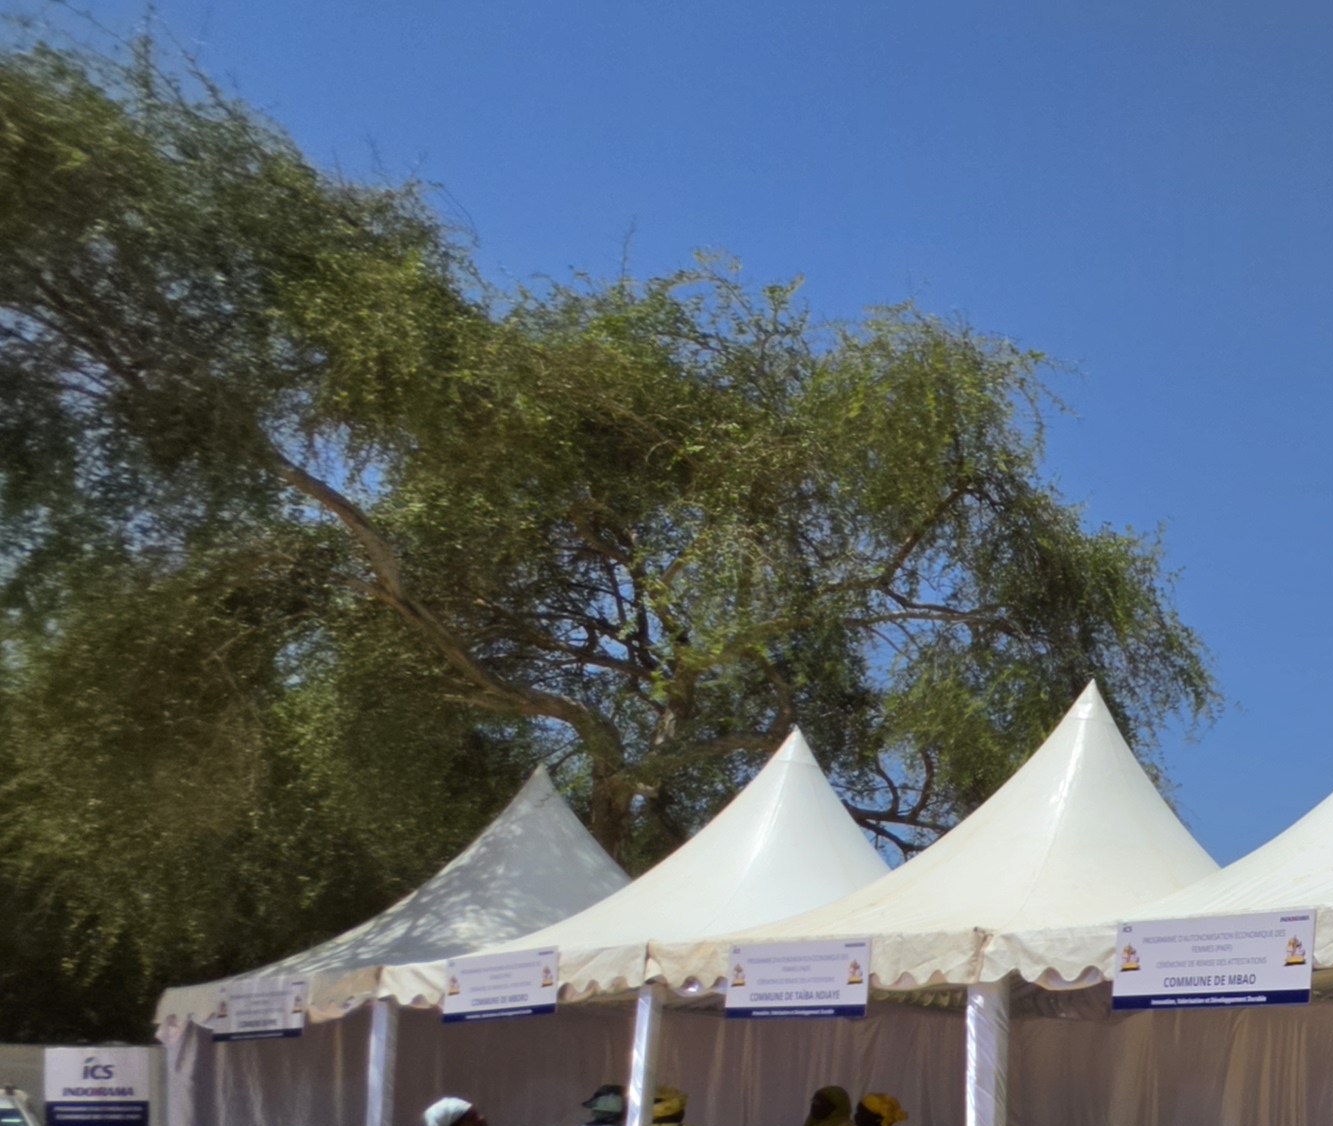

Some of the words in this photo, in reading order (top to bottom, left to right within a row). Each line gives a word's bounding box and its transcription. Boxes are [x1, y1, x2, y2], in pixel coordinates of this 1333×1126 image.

[1163, 976, 1212, 988] COMMUNE
[1214, 975, 1226, 986] DE
[1228, 973, 1256, 985] MBAO
